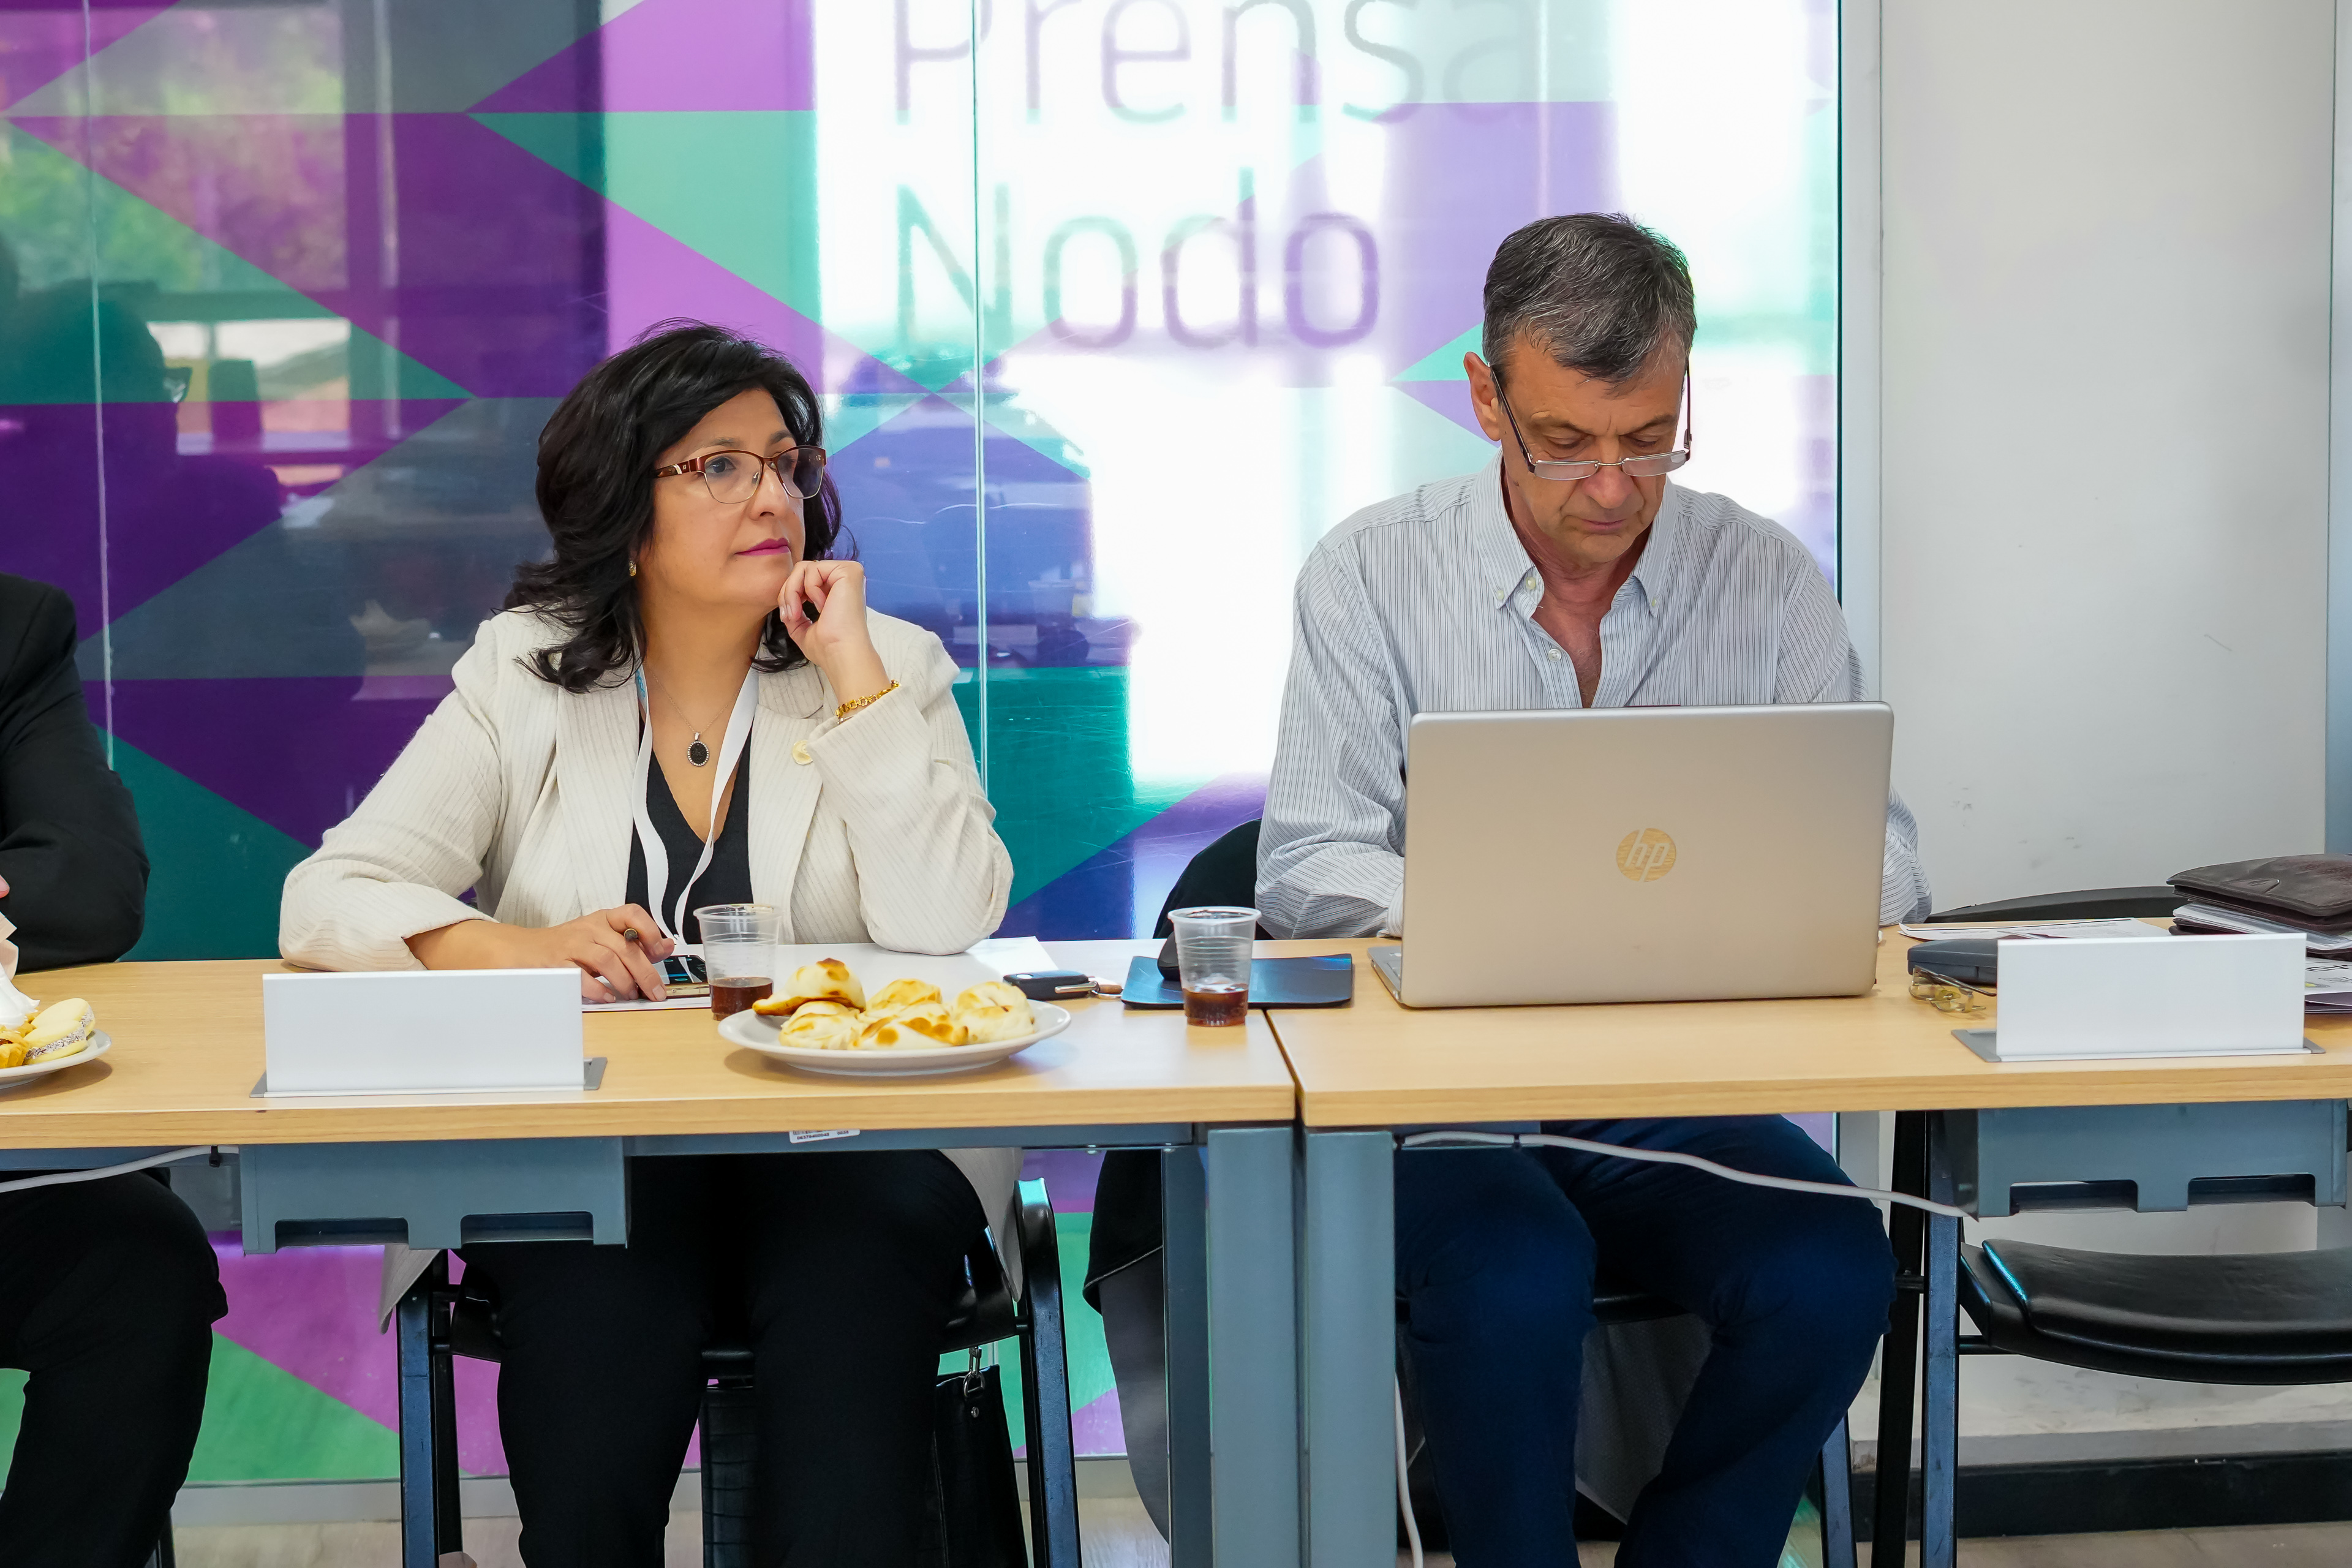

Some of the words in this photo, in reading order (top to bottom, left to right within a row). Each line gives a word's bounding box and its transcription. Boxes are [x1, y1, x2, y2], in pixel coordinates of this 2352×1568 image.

[895, 0, 1538, 125] Prensa
[896, 167, 1381, 351] Nodo
[1624, 827, 1671, 882] hp
